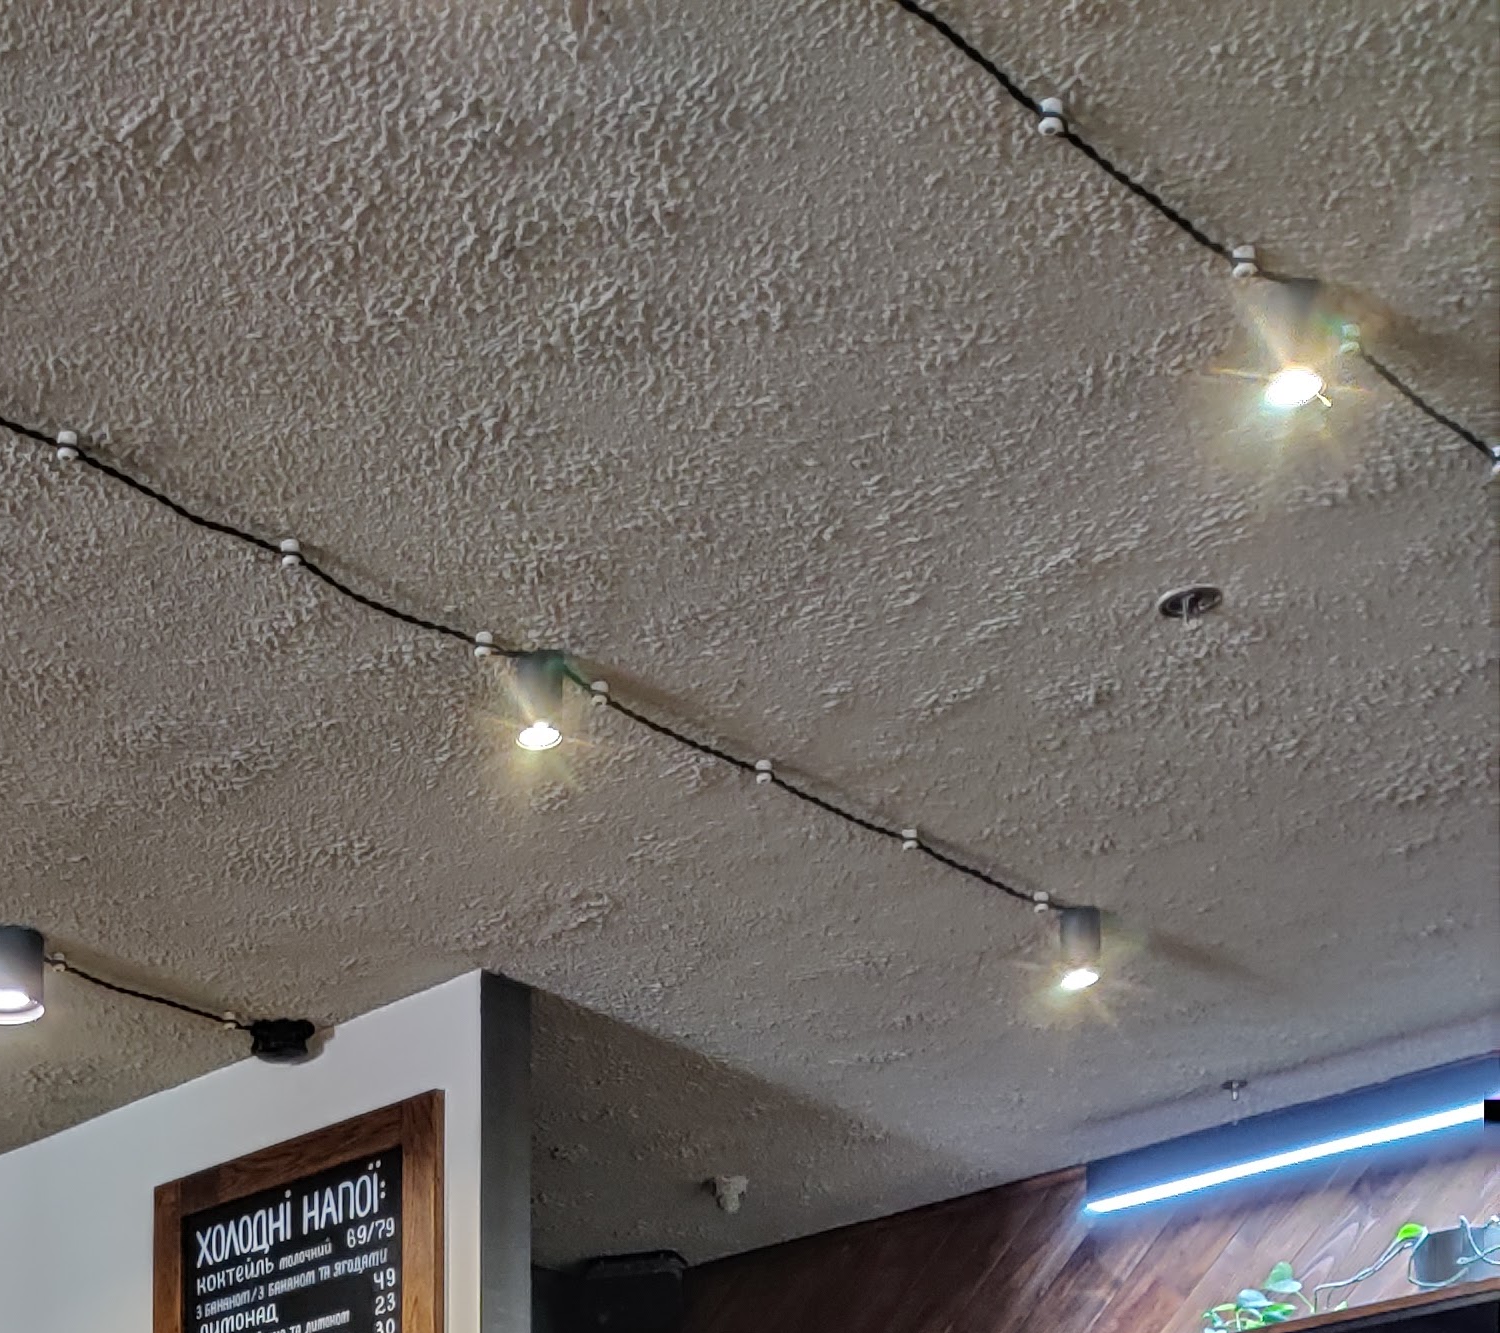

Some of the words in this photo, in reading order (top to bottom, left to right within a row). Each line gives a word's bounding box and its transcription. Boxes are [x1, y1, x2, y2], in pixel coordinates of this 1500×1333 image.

[346, 1216, 396, 1250] 69/79
[373, 1267, 397, 1291] 49
[374, 1291, 397, 1317] 23
